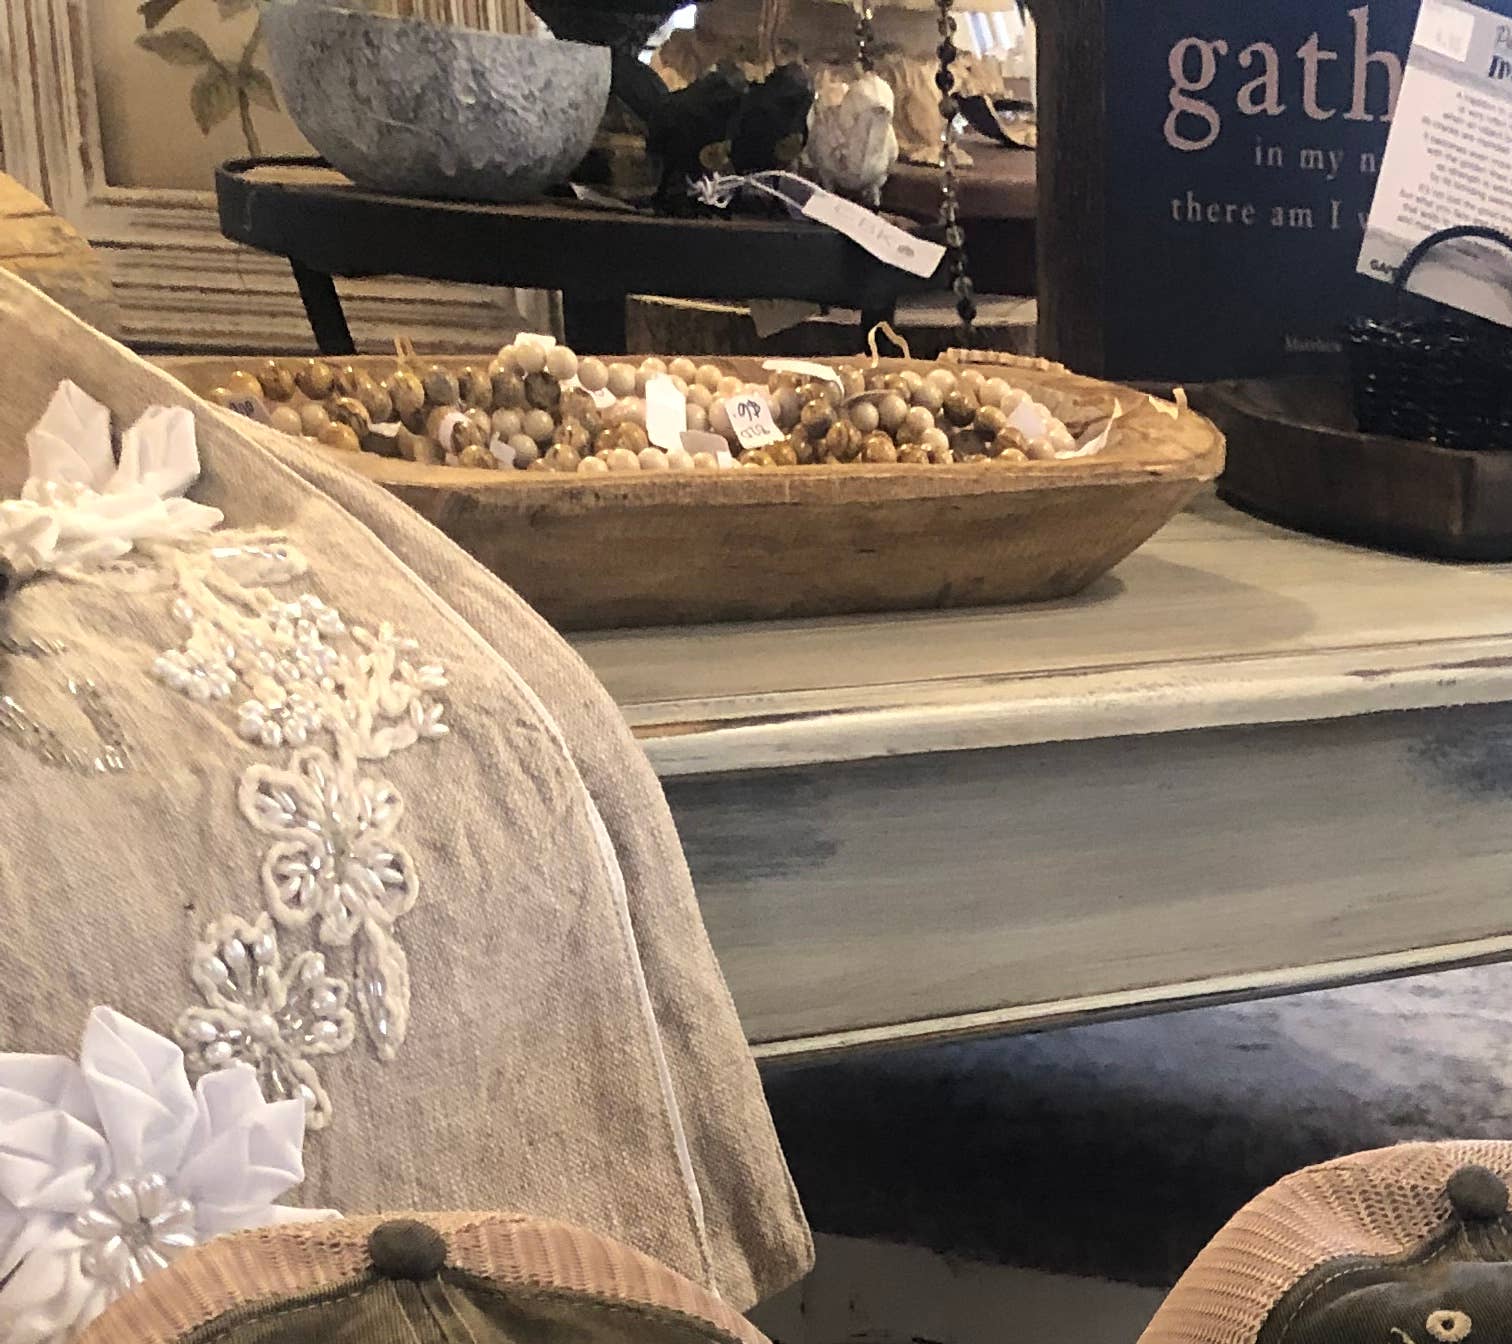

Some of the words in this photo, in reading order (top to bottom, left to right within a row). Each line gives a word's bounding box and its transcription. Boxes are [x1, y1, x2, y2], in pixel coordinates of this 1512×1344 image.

[1163, 4, 1404, 151] gath
[1254, 135, 1284, 168] in
[1299, 146, 1343, 181] my
[1169, 190, 1256, 226] there
[1270, 204, 1314, 229] am
[1330, 200, 1343, 230] I
